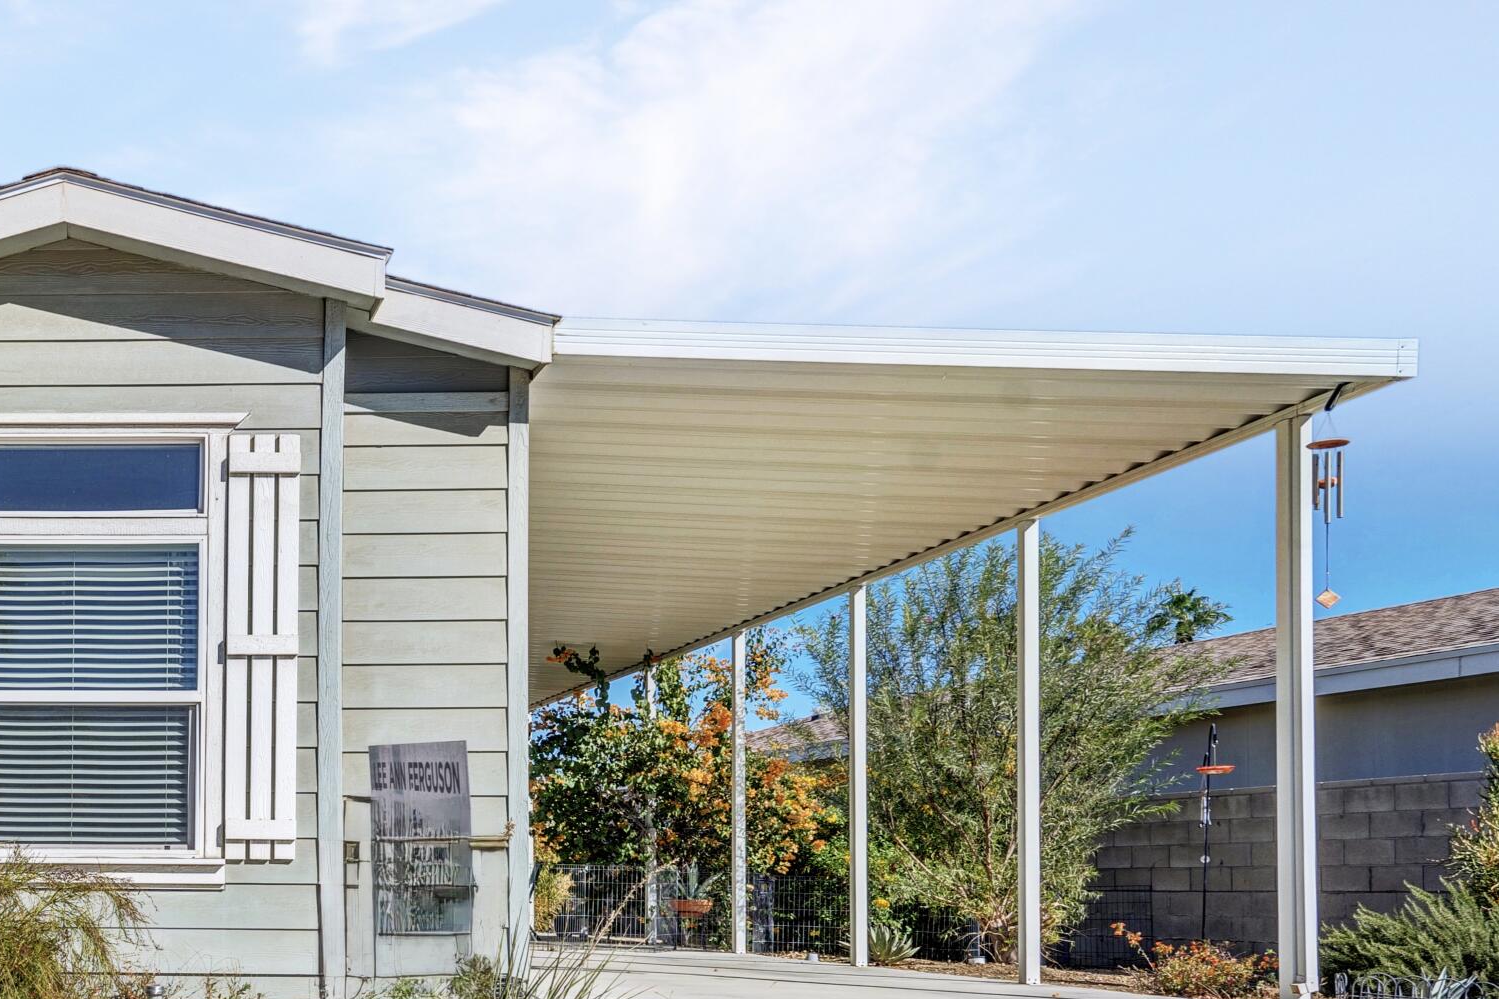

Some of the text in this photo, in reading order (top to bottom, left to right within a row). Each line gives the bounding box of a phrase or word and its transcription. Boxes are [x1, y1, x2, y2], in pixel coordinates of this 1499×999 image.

[372, 761, 461, 795] LEE ANN FERGUSON
